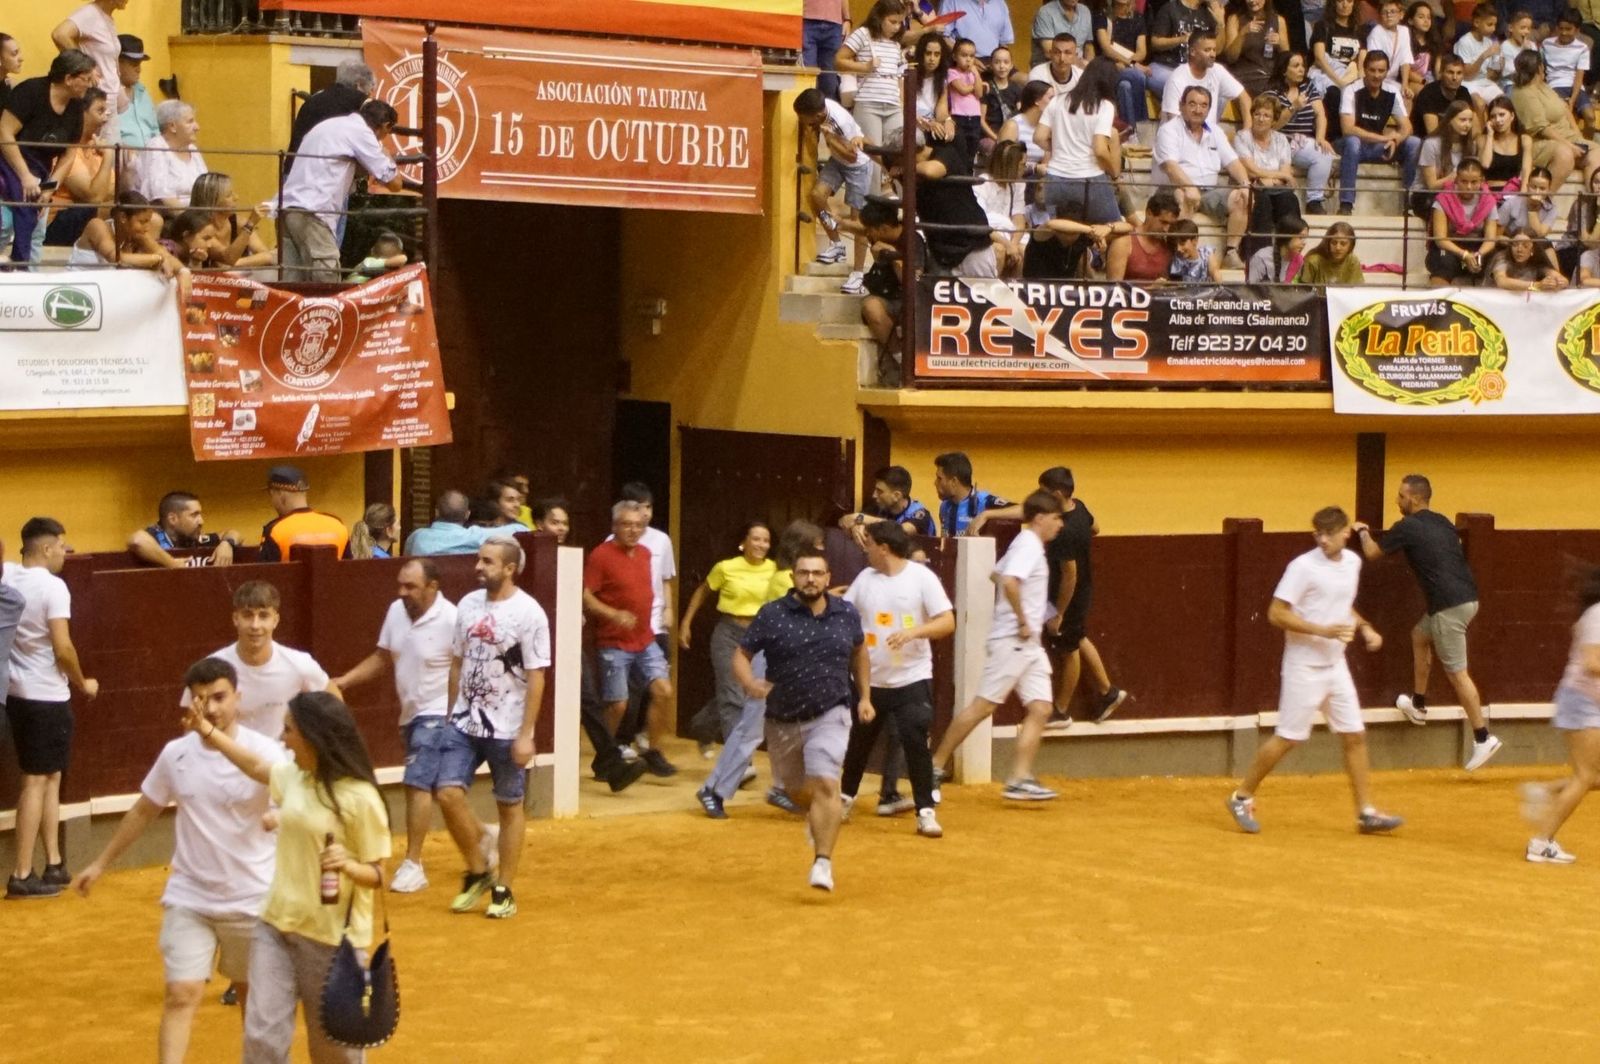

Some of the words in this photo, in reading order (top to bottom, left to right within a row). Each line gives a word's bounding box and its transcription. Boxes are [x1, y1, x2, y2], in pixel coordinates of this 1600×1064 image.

[536, 80, 631, 107] ASOCIACIÓN
[637, 87, 708, 112] TAURINA
[490, 111, 524, 156] 15
[537, 125, 574, 159] DE
[587, 117, 749, 169] OCTUBRE
[933, 280, 1151, 309] ELECTRICIDAD
[1196, 299, 1251, 311] Peñaranda
[1390, 302, 1447, 318] FRUTAS
[1168, 314, 1192, 326] Alba
[1194, 314, 1205, 326] de
[1206, 314, 1244, 326] Tormes
[1246, 313, 1310, 327] (Salamanca)
[930, 304, 1150, 360] REYES
[1365, 324, 1401, 357] La
[1404, 323, 1479, 357] Perla
[1168, 335, 1196, 352] Telf
[1197, 335, 1231, 352] 923
[1233, 335, 1257, 352] 37
[1259, 335, 1283, 352] 04
[1285, 335, 1307, 352] 30
[57, 359, 98, 367] SOLUCIONES
[294, 363, 307, 375] DE
[931, 357, 1070, 370] www.electricidadreyes.com
